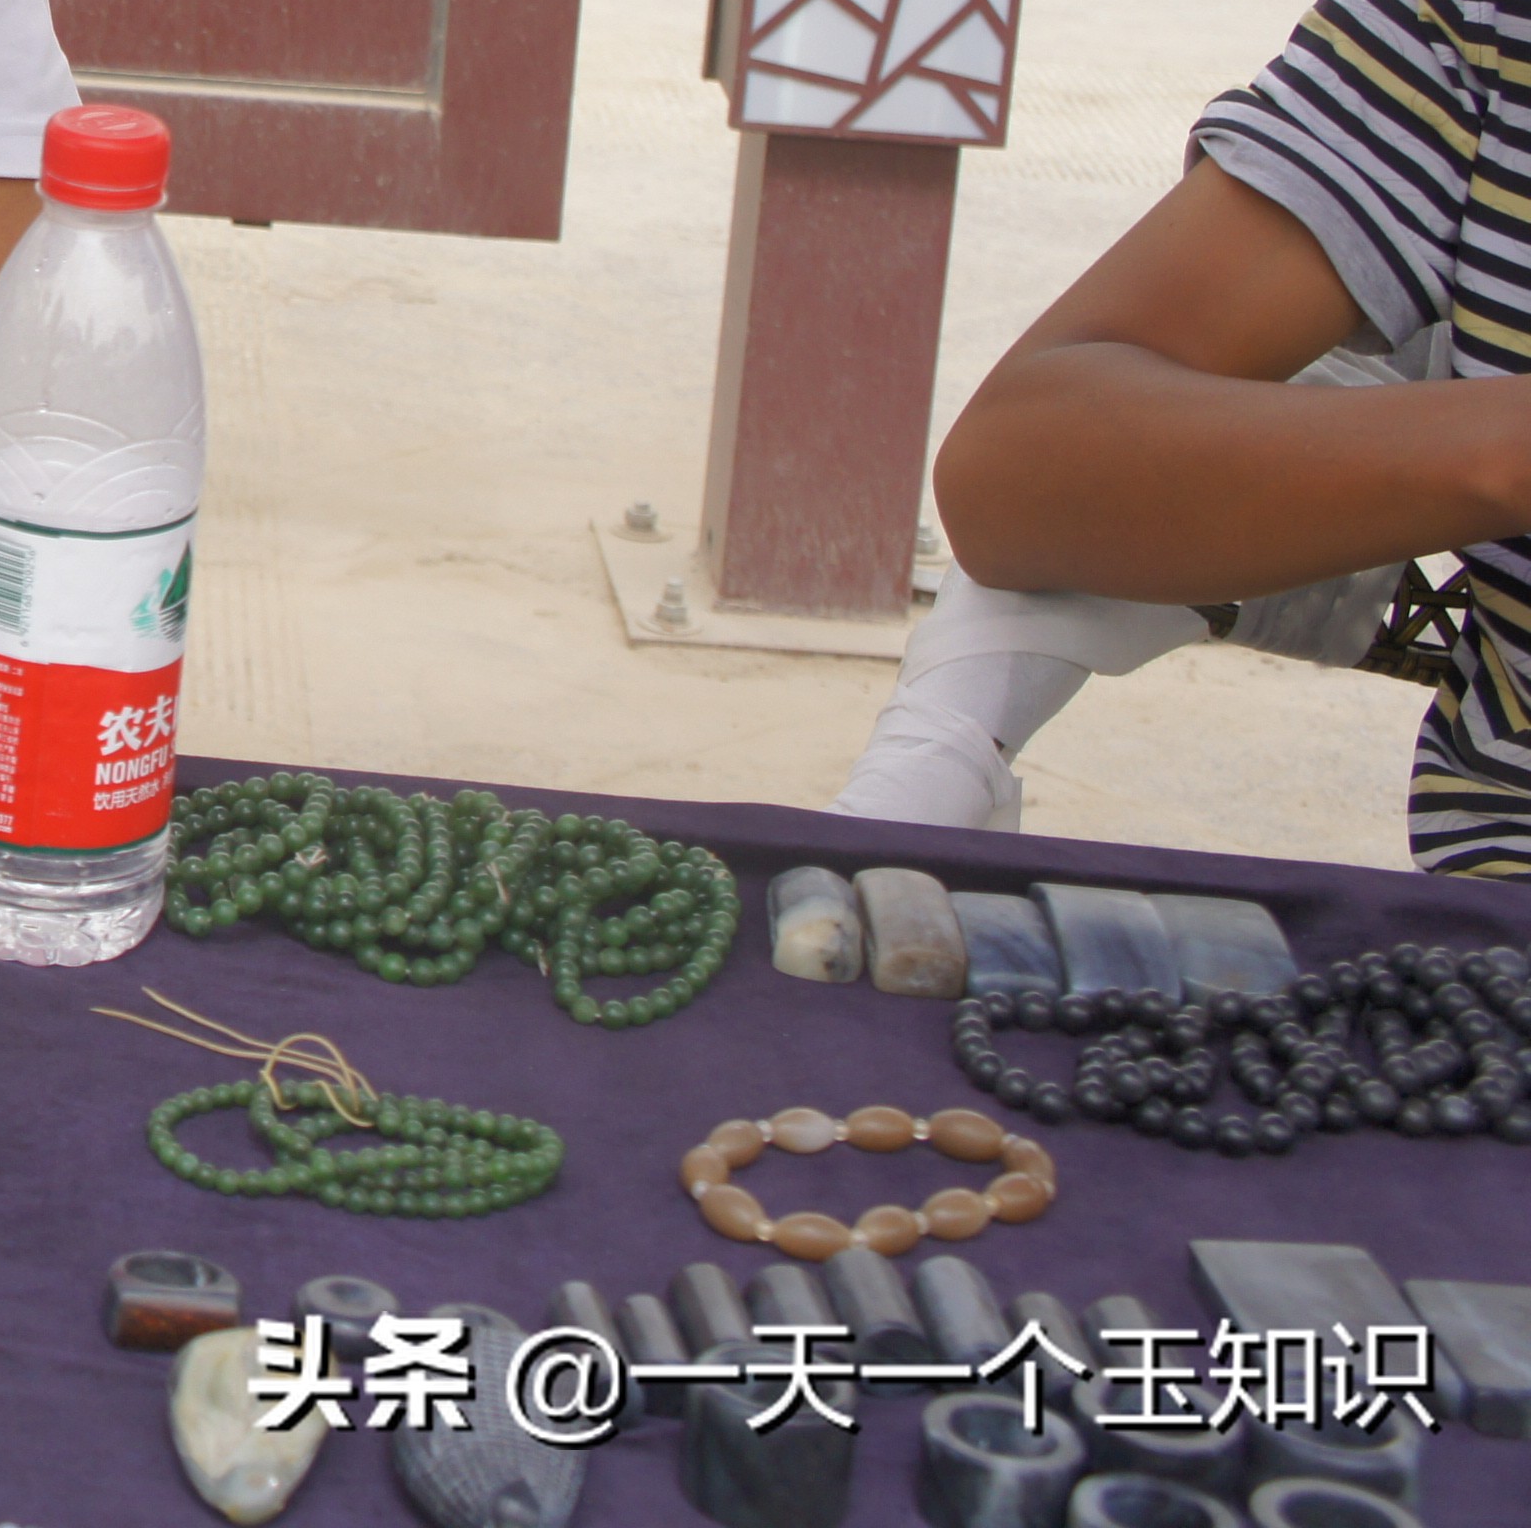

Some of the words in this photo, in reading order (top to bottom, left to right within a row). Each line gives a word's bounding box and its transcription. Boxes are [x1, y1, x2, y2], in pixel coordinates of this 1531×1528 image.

[97, 694, 178, 756] 农夫
[95, 744, 170, 786] NONGFU
[93, 778, 162, 811] 饮用天然水
